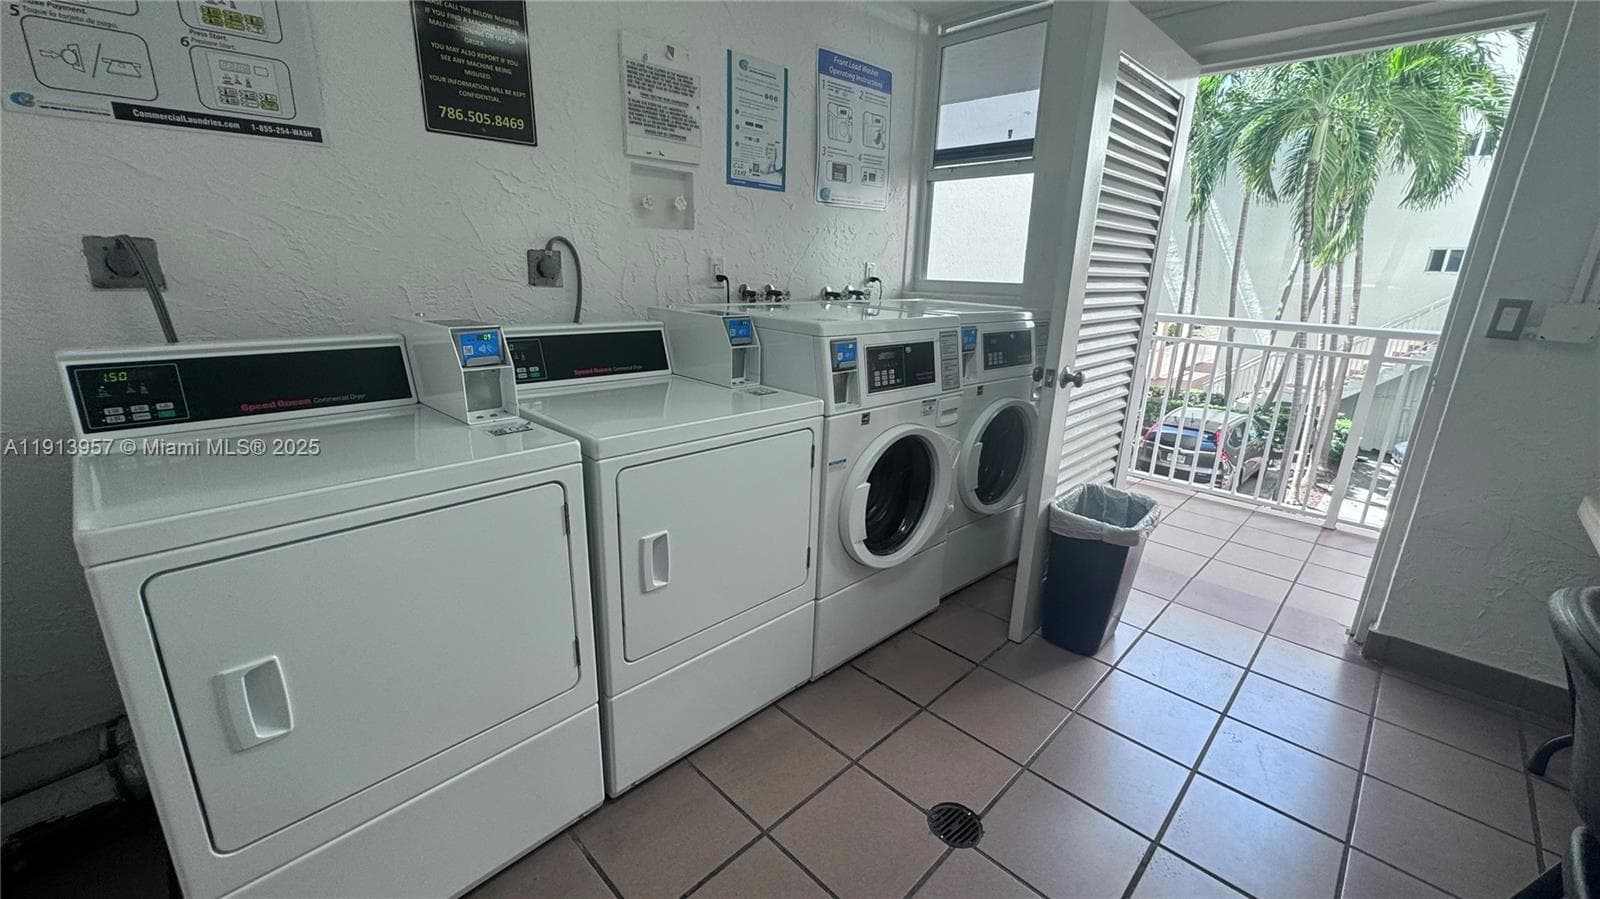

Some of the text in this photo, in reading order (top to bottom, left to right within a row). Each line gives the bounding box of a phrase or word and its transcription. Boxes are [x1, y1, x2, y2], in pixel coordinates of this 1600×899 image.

[10, 4, 19, 16] 5
[23, 5, 48, 16] Toque
[432, 8, 445, 17] YOU
[447, 12, 462, 22] FIND
[444, 2, 459, 11] CALL
[461, 6, 471, 14] THE
[472, 9, 493, 18] BELOW
[189, 29, 207, 38] Press
[180, 36, 190, 47] 6
[431, 42, 444, 50] YOU
[446, 45, 459, 53] MAY
[461, 48, 476, 56] ALSO
[477, 51, 500, 62] REPORT
[506, 58, 518, 66] YOU
[441, 54, 512, 74] SEE ANY MACHINE BEING
[833, 56, 848, 67] Front
[849, 62, 861, 71] Load
[428, 74, 447, 83] YOUR
[448, 78, 490, 92] INFORMATION
[491, 86, 504, 94] WILL
[829, 66, 855, 81] Operating
[856, 75, 883, 88] Instructions
[458, 90, 502, 103] CONFIDENTIAL.
[859, 90, 864, 100] 2
[132, 108, 313, 138] CommercialLaundries.com 1-855-254-WASH
[438, 106, 524, 130] 786.505.8469
[240, 401, 276, 412] Speed
[278, 398, 312, 408] Queen
[312, 394, 349, 404] Commercial
